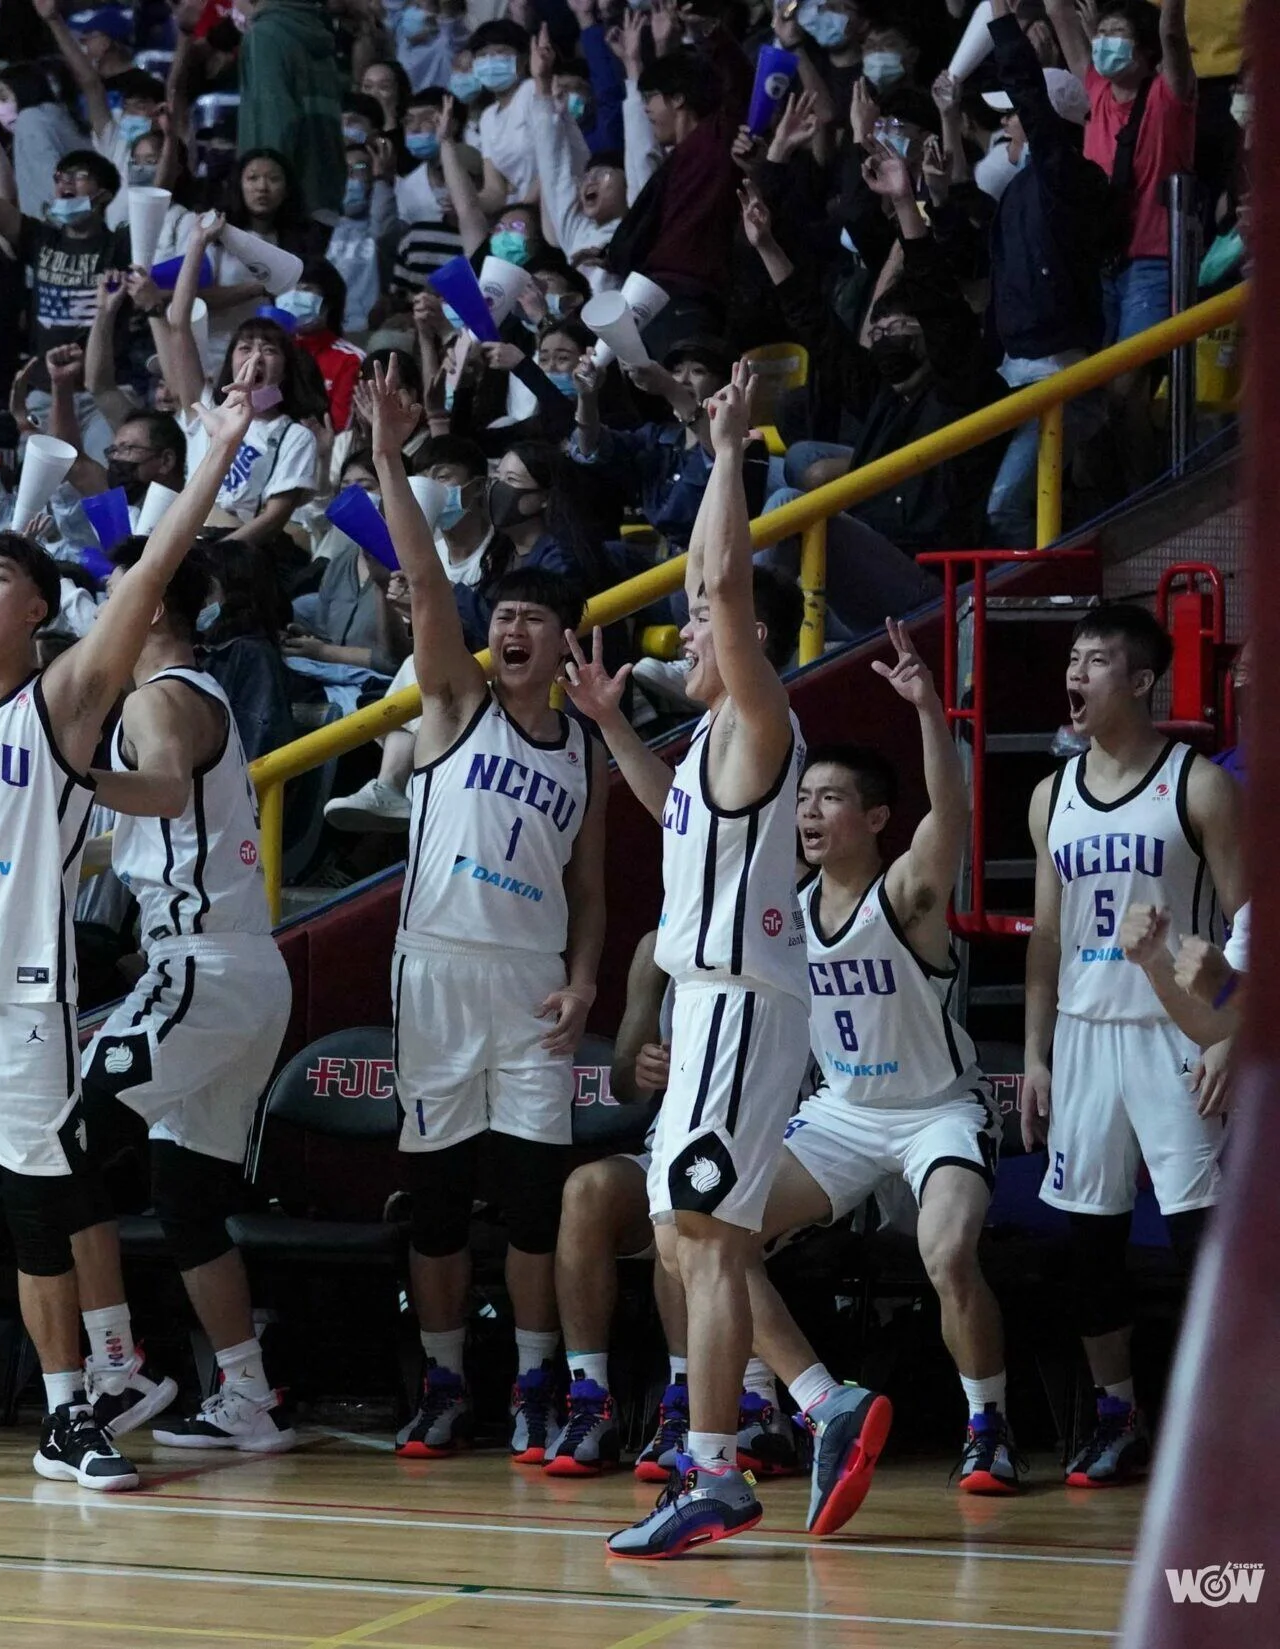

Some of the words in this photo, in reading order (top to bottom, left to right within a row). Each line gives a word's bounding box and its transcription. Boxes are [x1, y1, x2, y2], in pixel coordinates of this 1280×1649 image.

[464, 754, 577, 832] NCCU
[505, 817, 523, 861] 1
[1053, 833, 1165, 883] NCCU
[472, 866, 544, 902] DAIKIN
[1094, 889, 1115, 937] 5
[808, 959, 896, 995] CCU
[834, 1010, 858, 1052] 8
[834, 1061, 899, 1077] DAIKIN
[1053, 1151, 1065, 1191] 5
